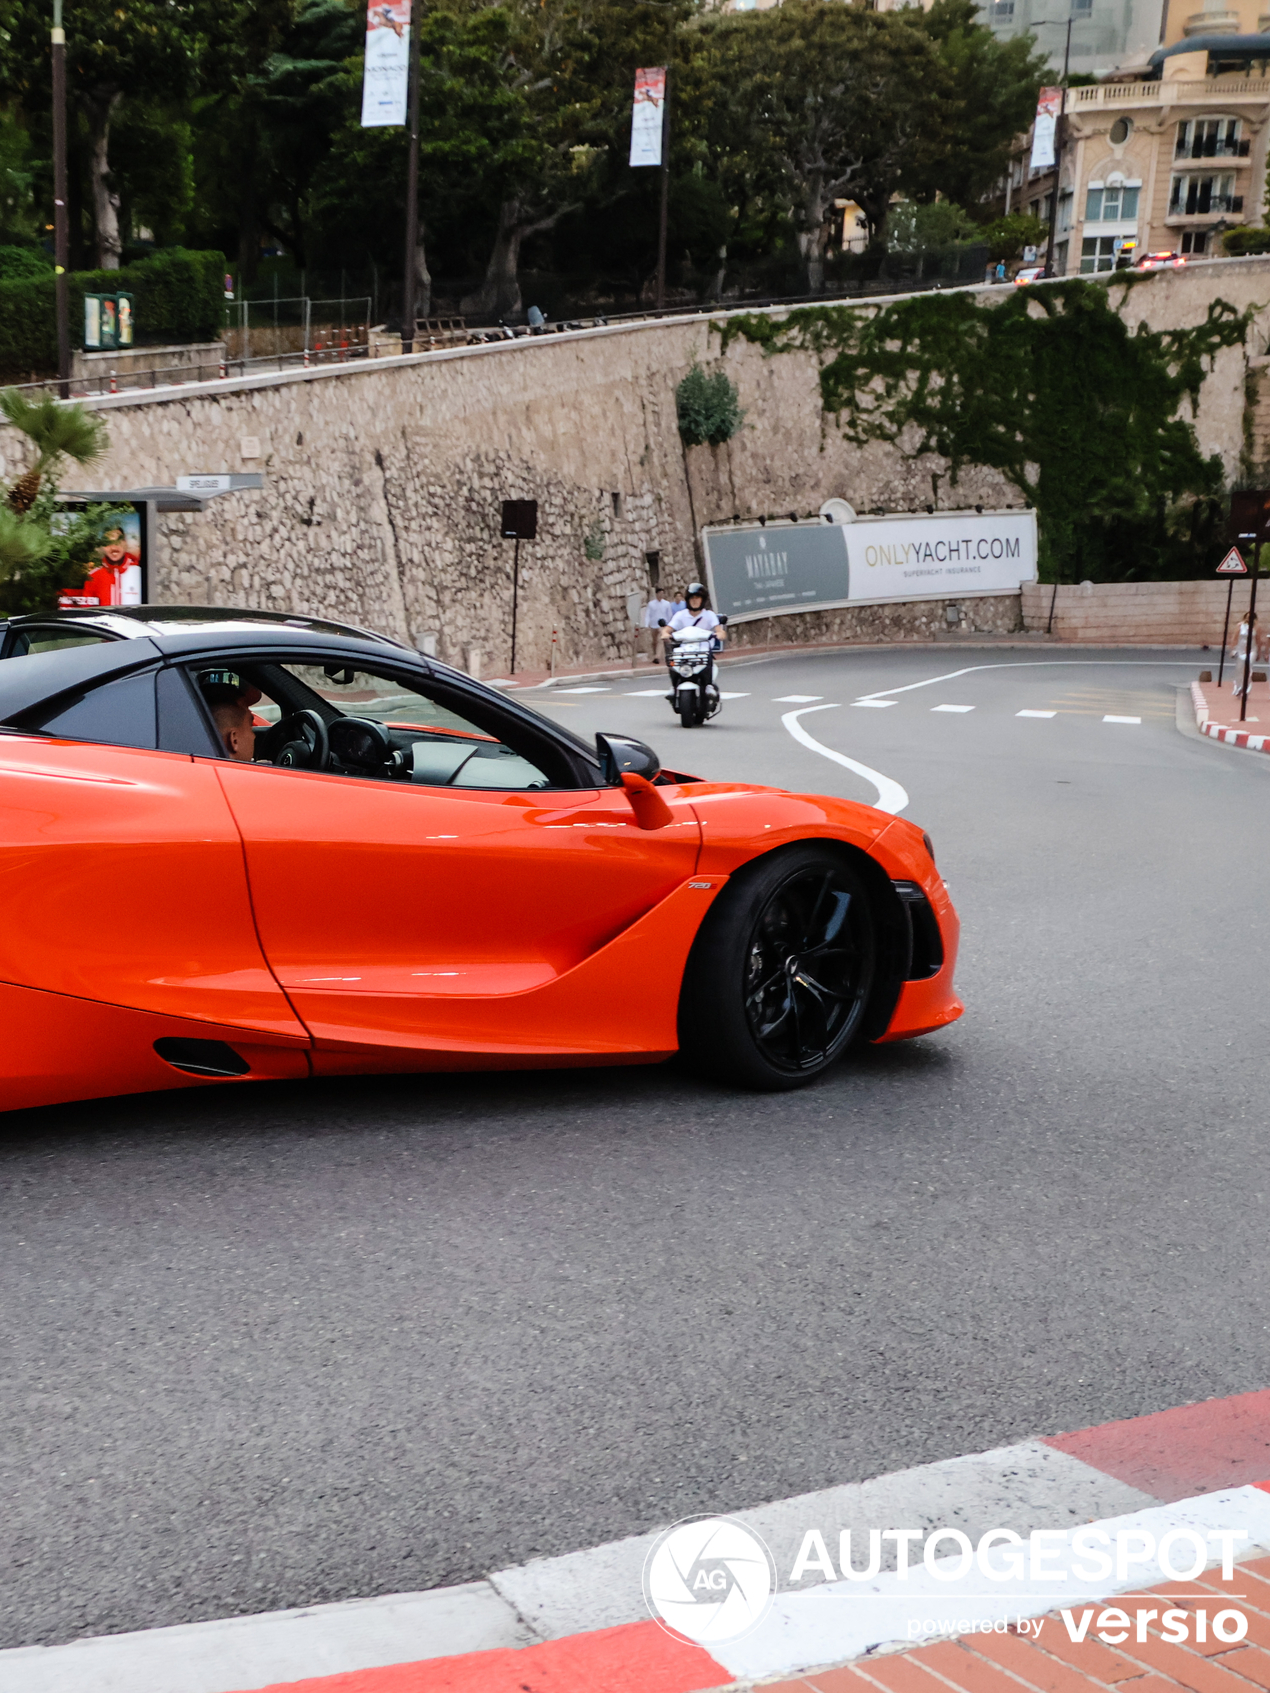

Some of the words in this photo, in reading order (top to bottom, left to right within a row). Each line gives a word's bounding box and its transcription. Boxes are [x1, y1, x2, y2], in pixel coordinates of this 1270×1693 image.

[865, 537, 1020, 567] ONLYYACHT.COM
[903, 568, 943, 578] SUPERYACHT
[945, 566, 982, 575] INSURANCE
